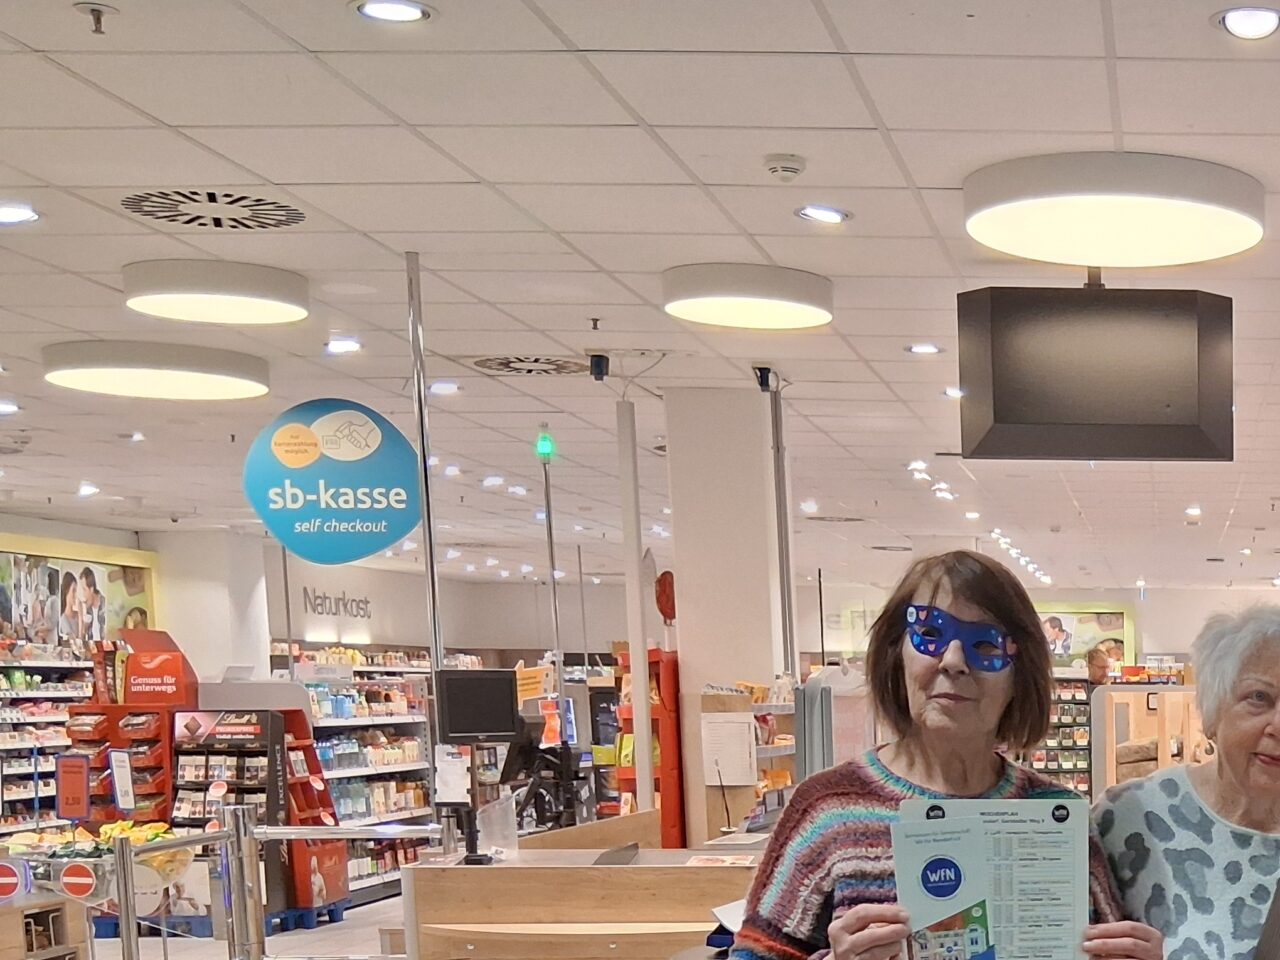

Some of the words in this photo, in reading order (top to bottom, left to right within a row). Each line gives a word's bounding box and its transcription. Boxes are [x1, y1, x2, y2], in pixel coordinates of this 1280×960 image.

[268, 479, 408, 510] sb-kasse
[294, 518, 322, 533] self
[323, 518, 389, 533] checkout
[303, 586, 372, 619] Naturkost
[130, 675, 162, 684] Genuss
[163, 675, 177, 684] für
[131, 684, 177, 694] unterwegs
[275, 744, 285, 805] EXCELLENCE
[926, 867, 956, 883] WfN
